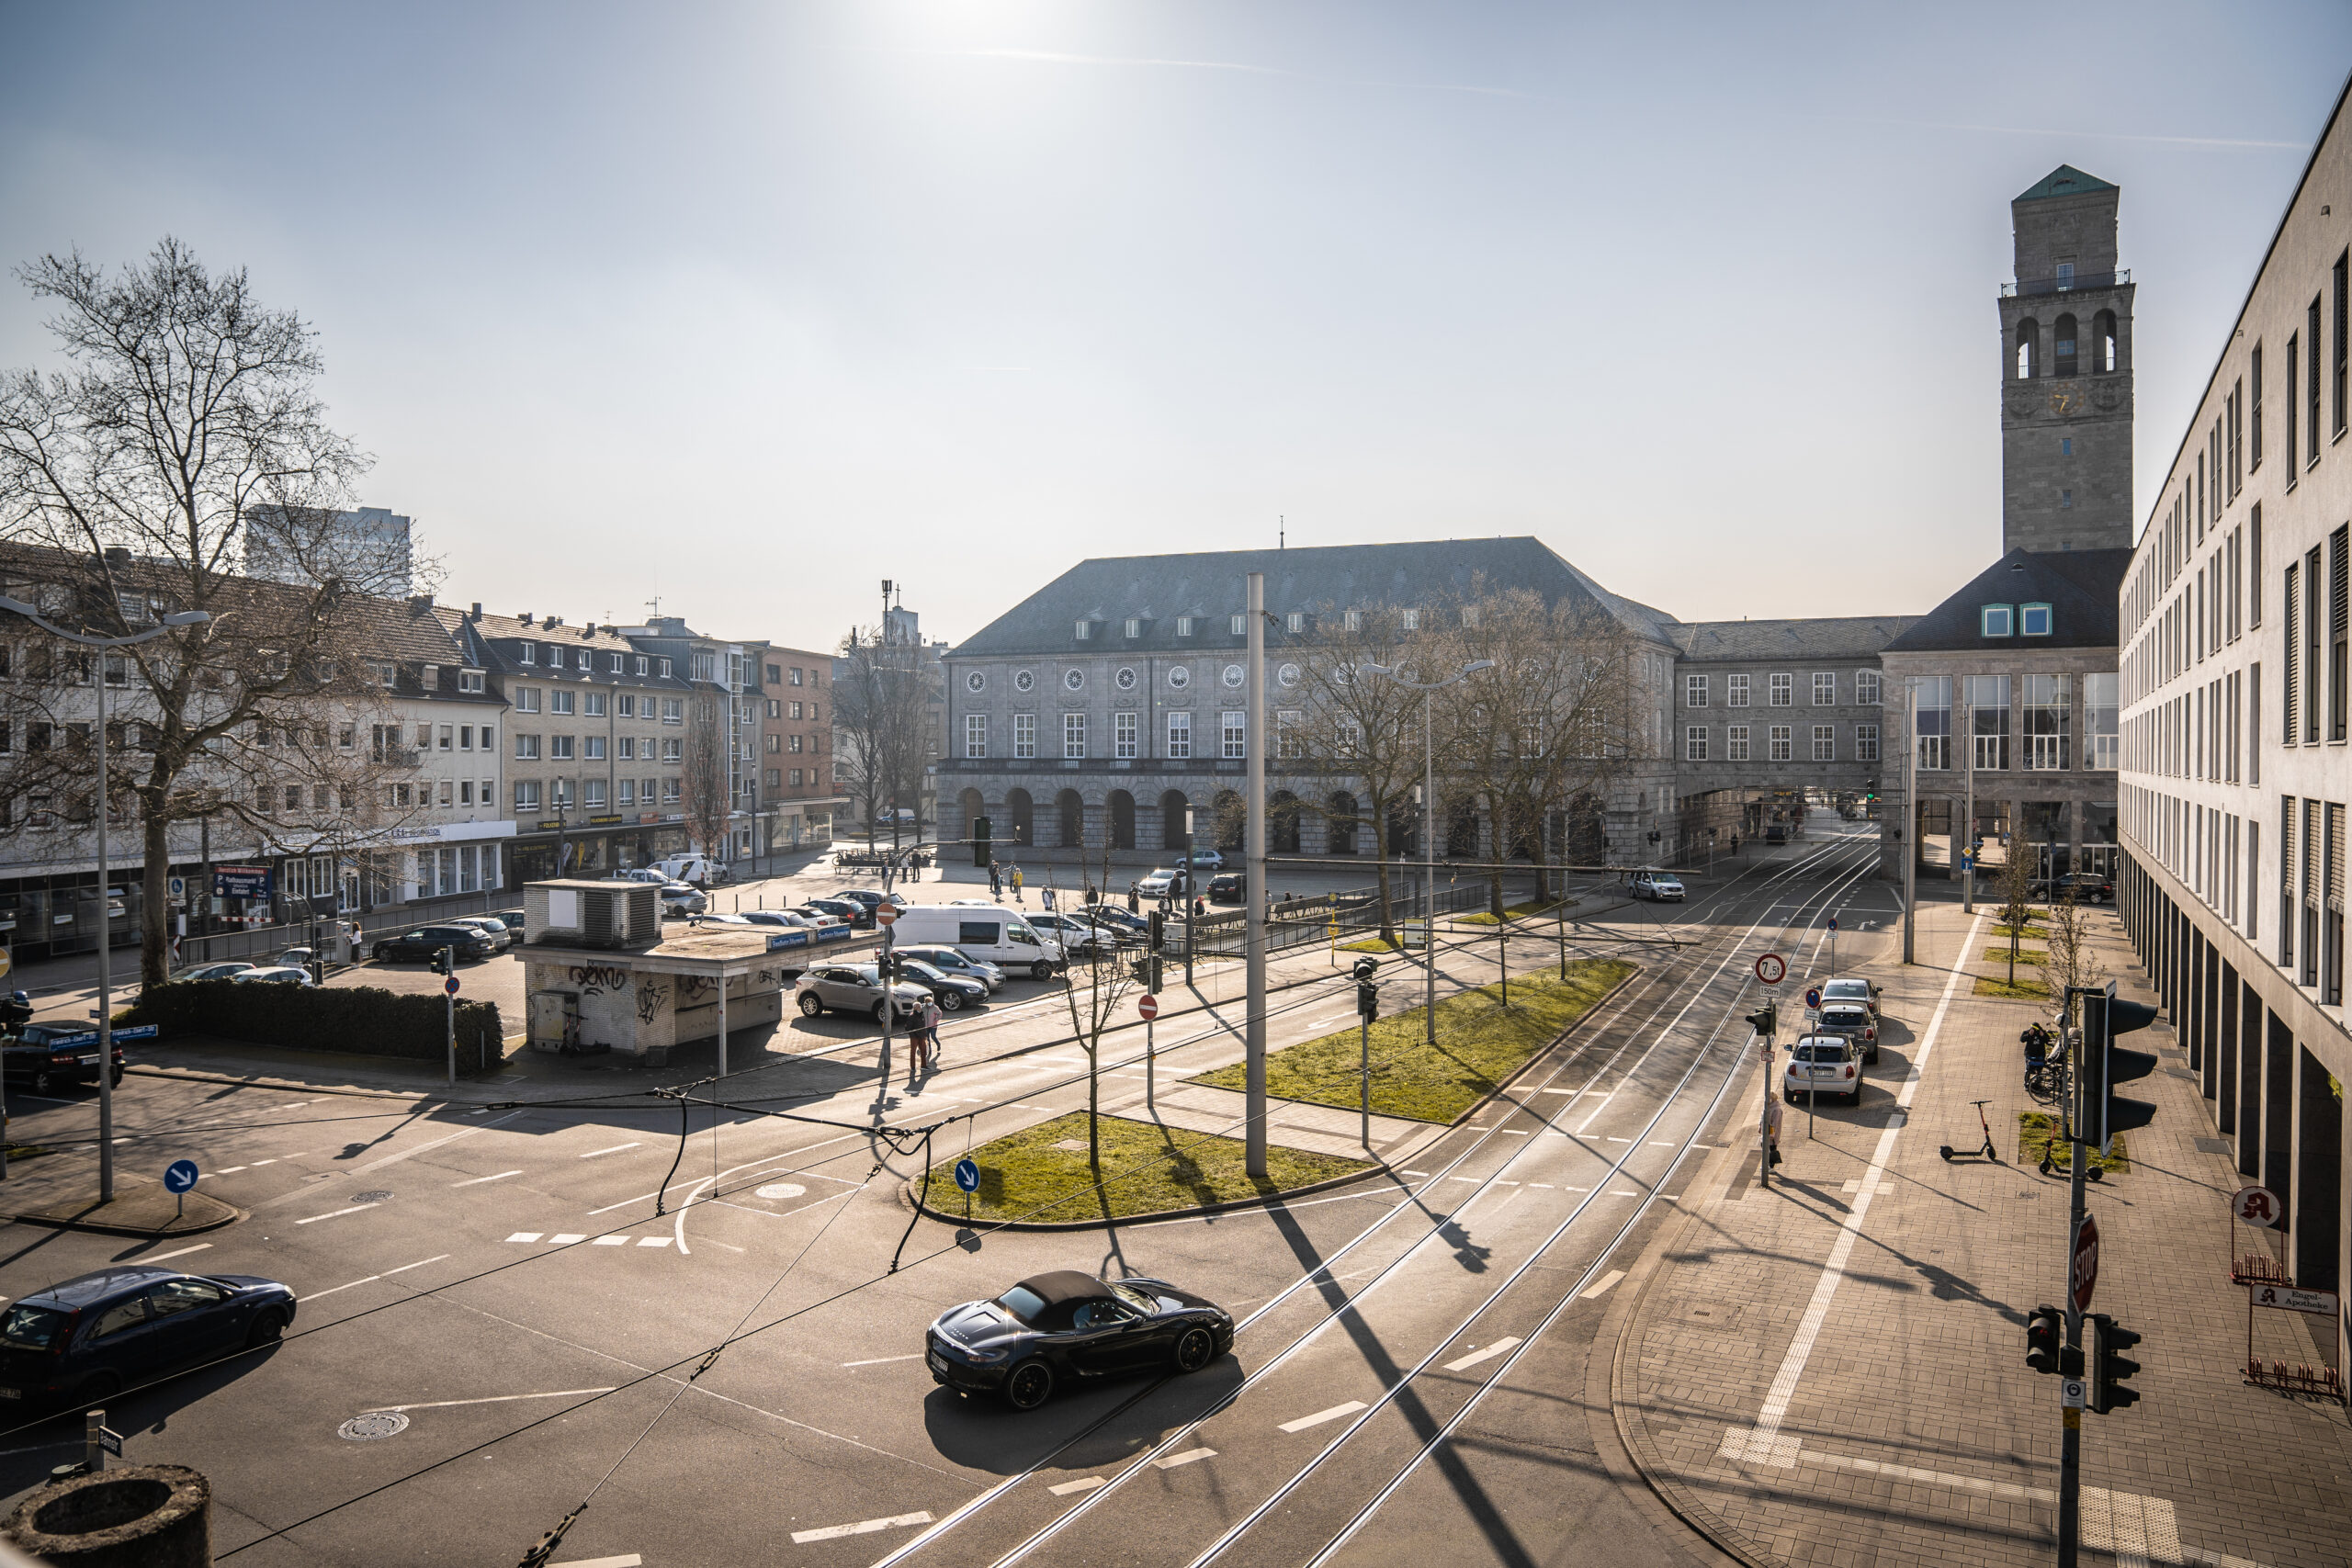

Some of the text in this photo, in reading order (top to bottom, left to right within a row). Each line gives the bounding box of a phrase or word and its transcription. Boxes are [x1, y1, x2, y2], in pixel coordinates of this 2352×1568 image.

[225, 876, 257, 885] Rathausmarkt
[1760, 987, 1779, 996] 150m
[2075, 1241, 2097, 1292] STOP
[2291, 1290, 2322, 1301] Engel-
[2285, 1298, 2328, 1310] Apotheke
